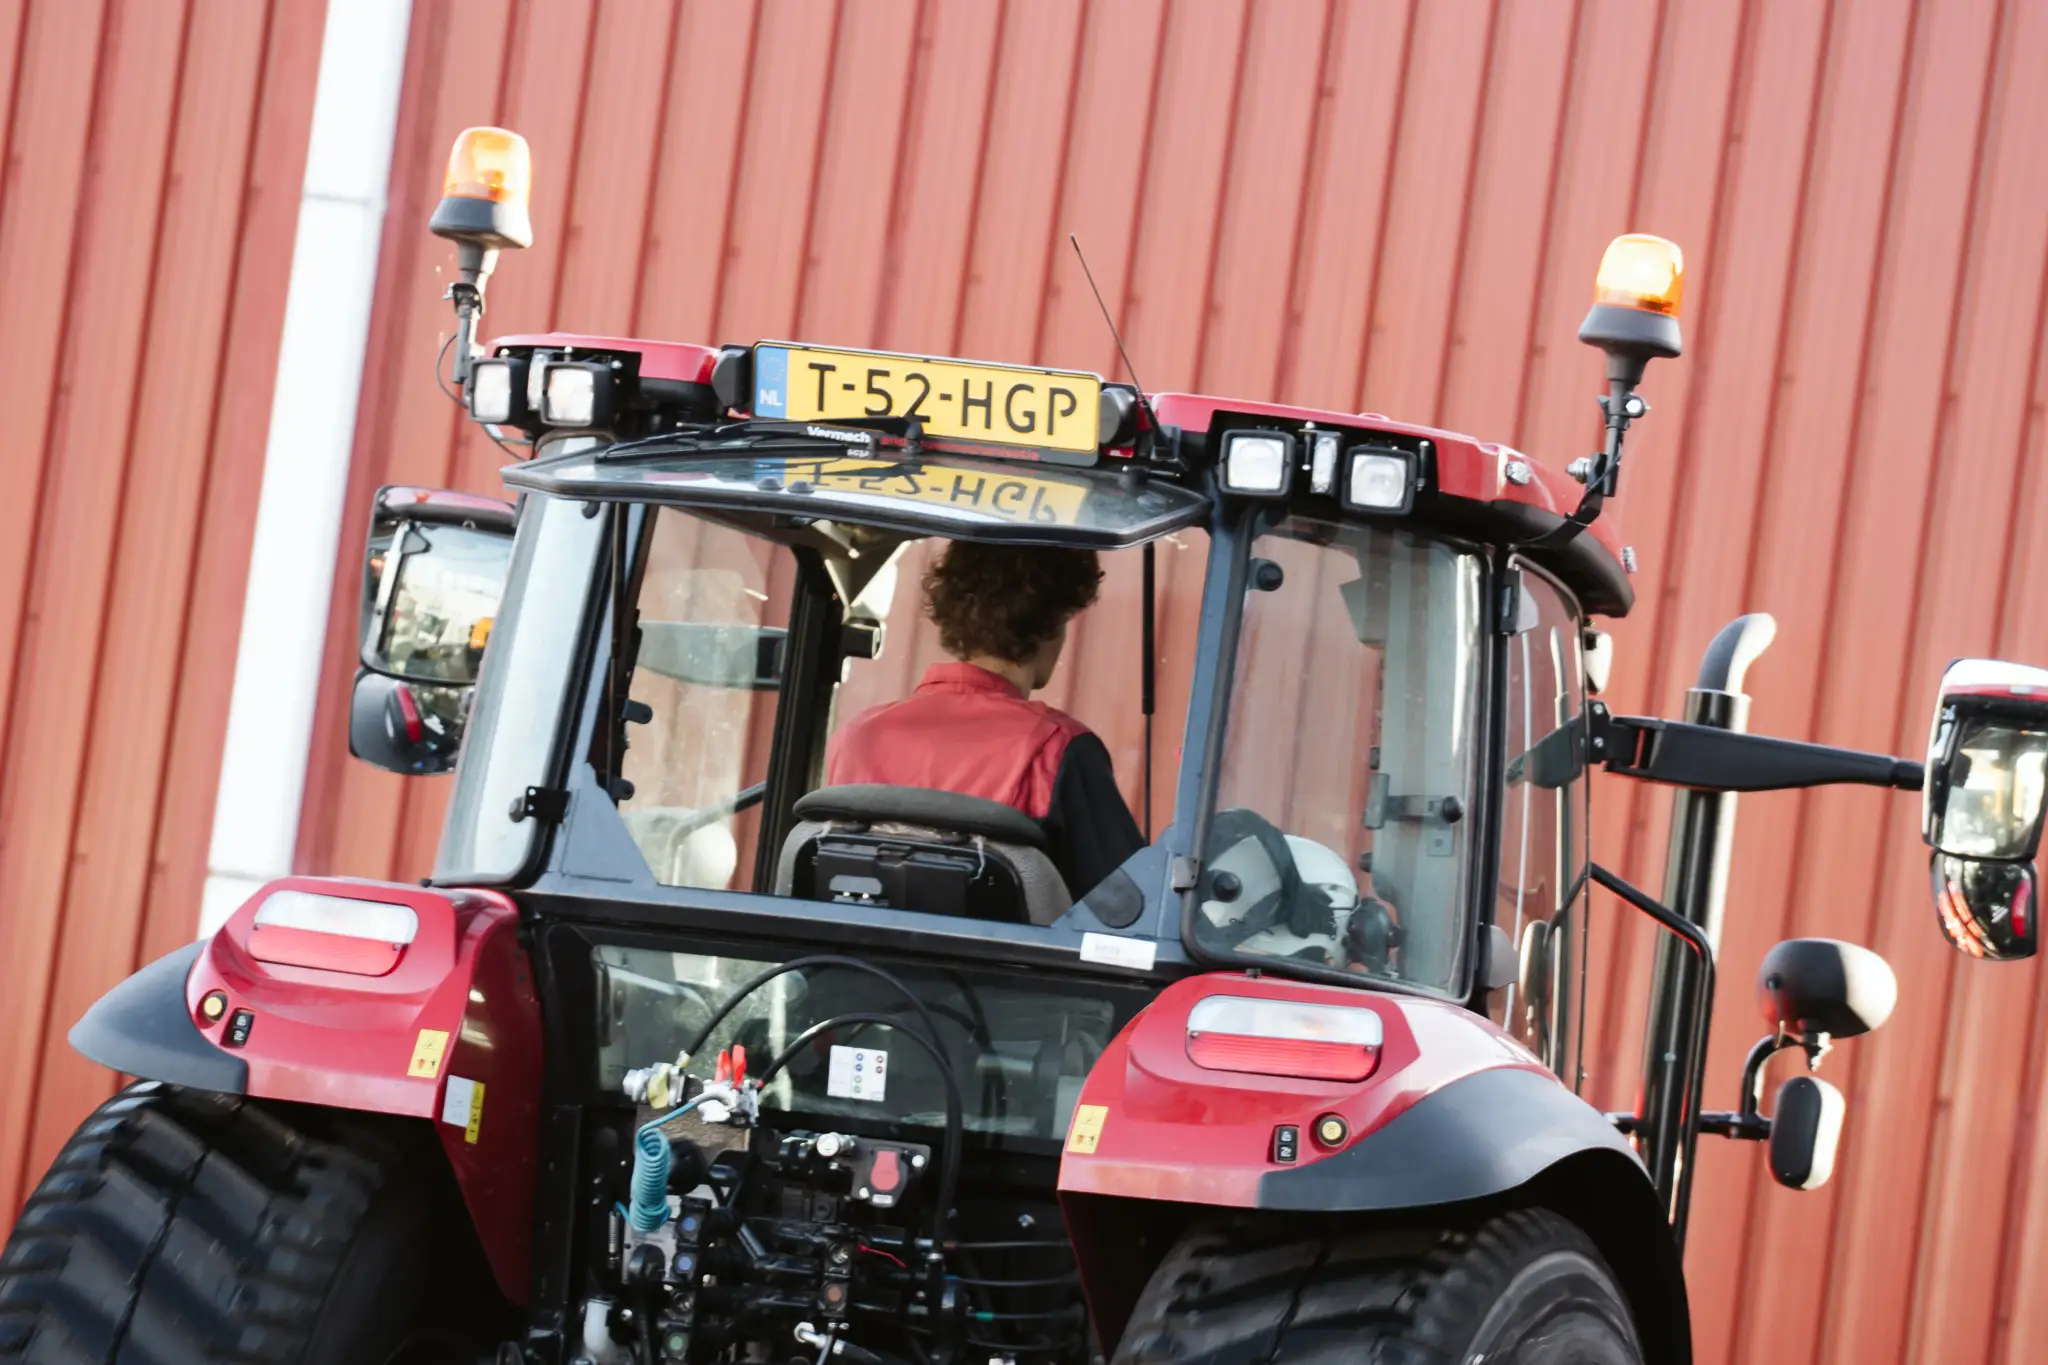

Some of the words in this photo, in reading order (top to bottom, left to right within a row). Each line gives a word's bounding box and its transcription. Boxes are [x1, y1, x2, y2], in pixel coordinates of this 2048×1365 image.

[760, 388, 784, 406] NL
[808, 362, 1077, 435] T-52-HGP
[807, 425, 871, 443] Vermech
